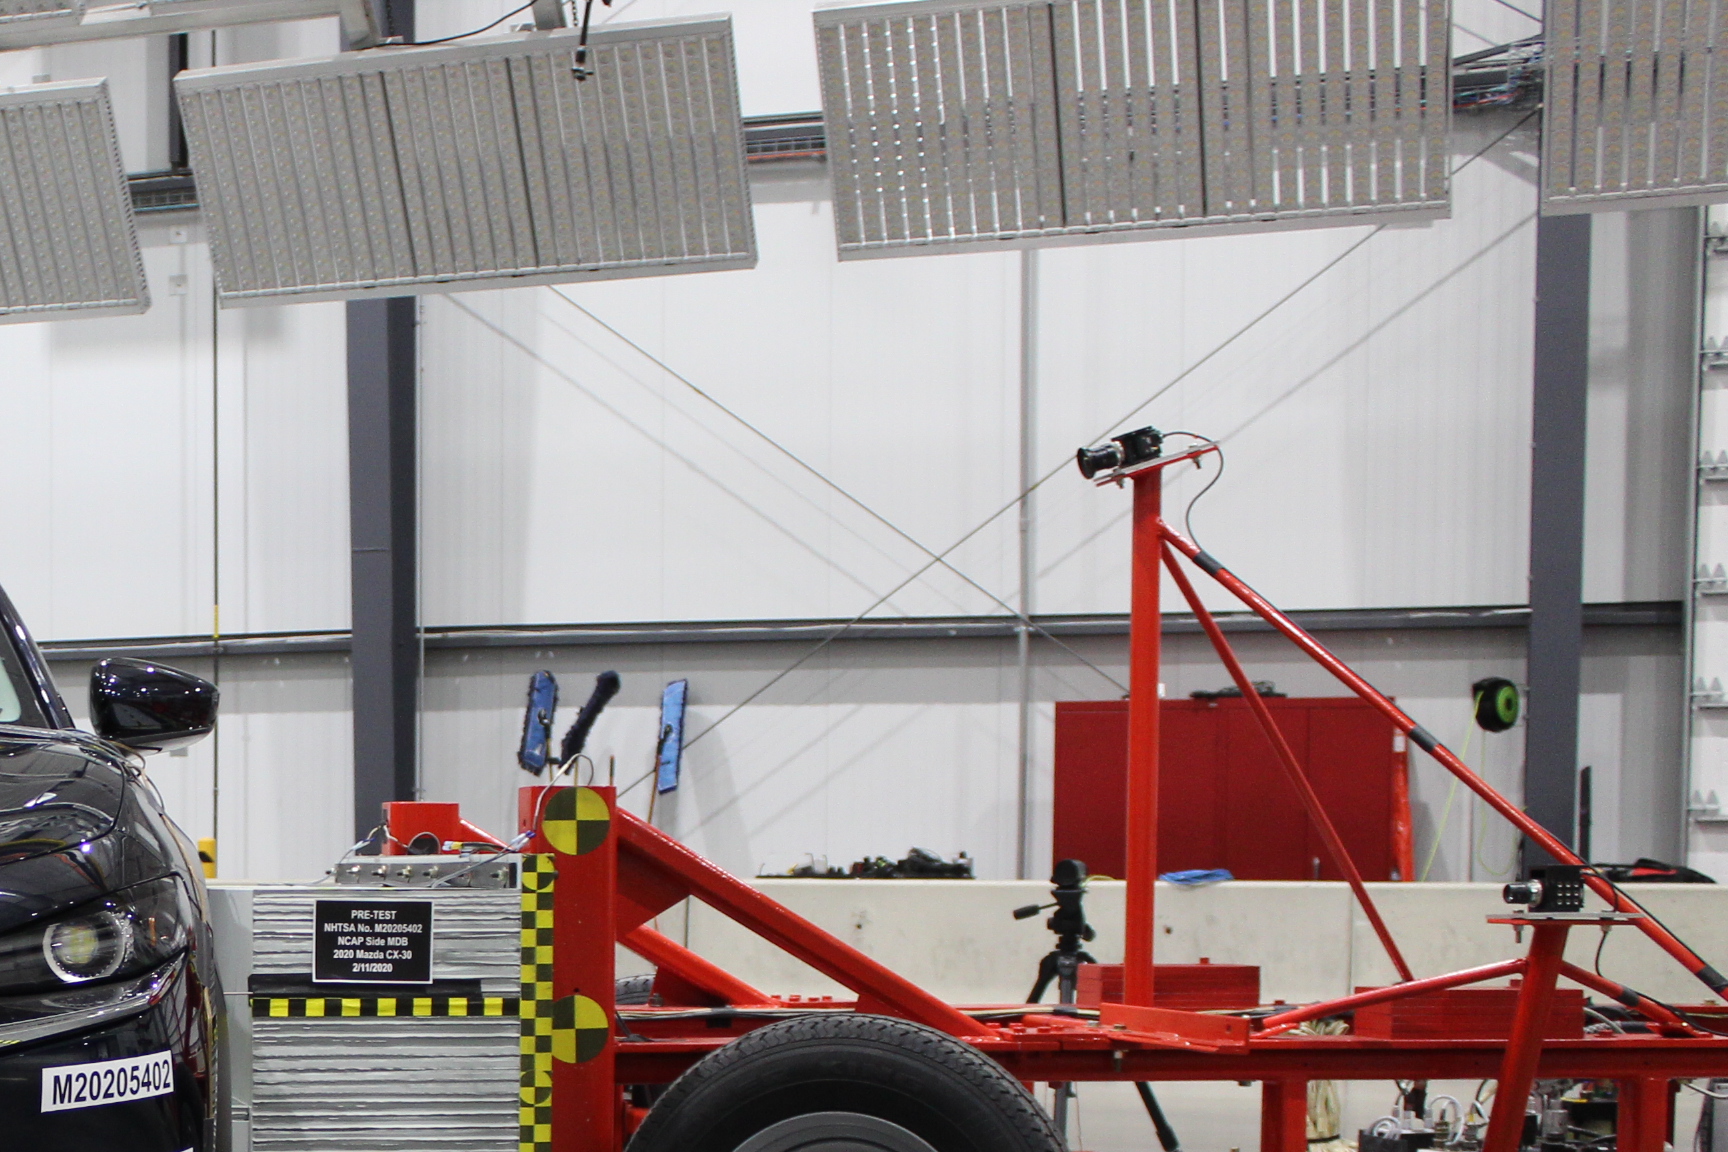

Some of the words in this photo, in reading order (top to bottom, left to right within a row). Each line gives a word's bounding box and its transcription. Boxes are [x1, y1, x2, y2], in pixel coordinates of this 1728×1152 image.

[351, 910, 397, 919] PRE-TEST
[324, 923, 355, 932] NHTSA
[358, 924, 372, 933] No.
[374, 924, 423, 933] M20205402
[338, 936, 364, 946] NCAP
[366, 937, 385, 946] Side
[387, 937, 408, 946] MDB
[333, 950, 354, 959] 2020
[356, 950, 384, 959] Mazda
[386, 950, 412, 959] CX-30
[352, 963, 393, 972] 2/11/2020
[52, 1059, 171, 1105] M20205402
